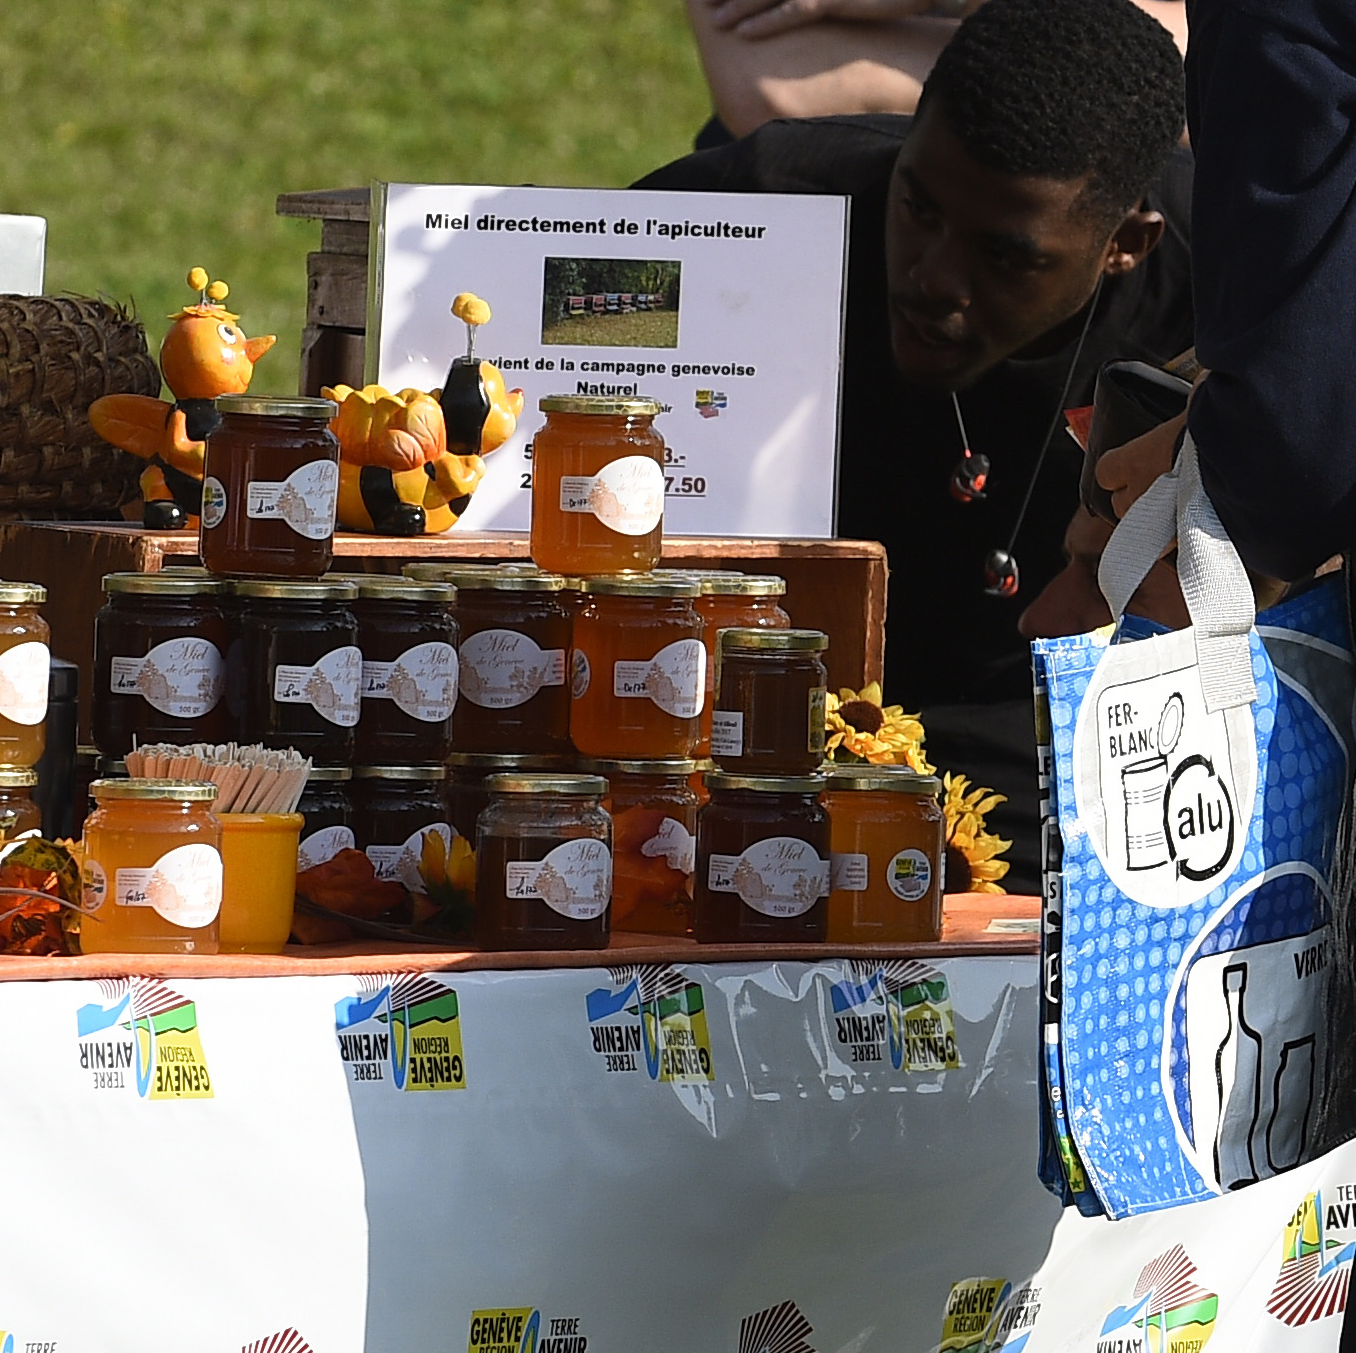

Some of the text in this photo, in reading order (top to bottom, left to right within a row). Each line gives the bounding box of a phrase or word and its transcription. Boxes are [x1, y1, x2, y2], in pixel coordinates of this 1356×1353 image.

[425, 213, 767, 240] Miel directement de l'apiculteur
[535, 357, 555, 371] de
[560, 357, 575, 372] la
[579, 361, 666, 377] campagne
[671, 362, 756, 378] genevoise
[576, 381, 638, 396] Naturel
[170, 641, 207, 661] Miel
[478, 635, 520, 653] Miel
[1108, 703, 1138, 728] FER-
[1178, 793, 1223, 839] alu
[568, 845, 601, 862] Miel
[766, 842, 803, 860] Miel
[590, 1025, 641, 1053] AVENIR
[835, 1014, 886, 1043] AVENIR
[78, 1042, 133, 1069] AVENIR
[338, 1033, 389, 1061] AVENIR
[412, 1036, 450, 1055] RÉGION
[851, 1043, 882, 1062] TERRE
[905, 1036, 956, 1068] GENÈVE
[353, 1062, 384, 1081] TERRE
[409, 1054, 463, 1088] GENÈVE
[605, 1054, 638, 1072] TERRE
[662, 1047, 711, 1080] GENÈVE
[93, 1071, 125, 1089] TERRE
[156, 1065, 211, 1096] GENÈVE
[948, 1283, 996, 1316] GENÈVE
[471, 1312, 523, 1345] GENÈVE
[550, 1318, 580, 1337] TERRE
[953, 1314, 986, 1333] RÉGION
